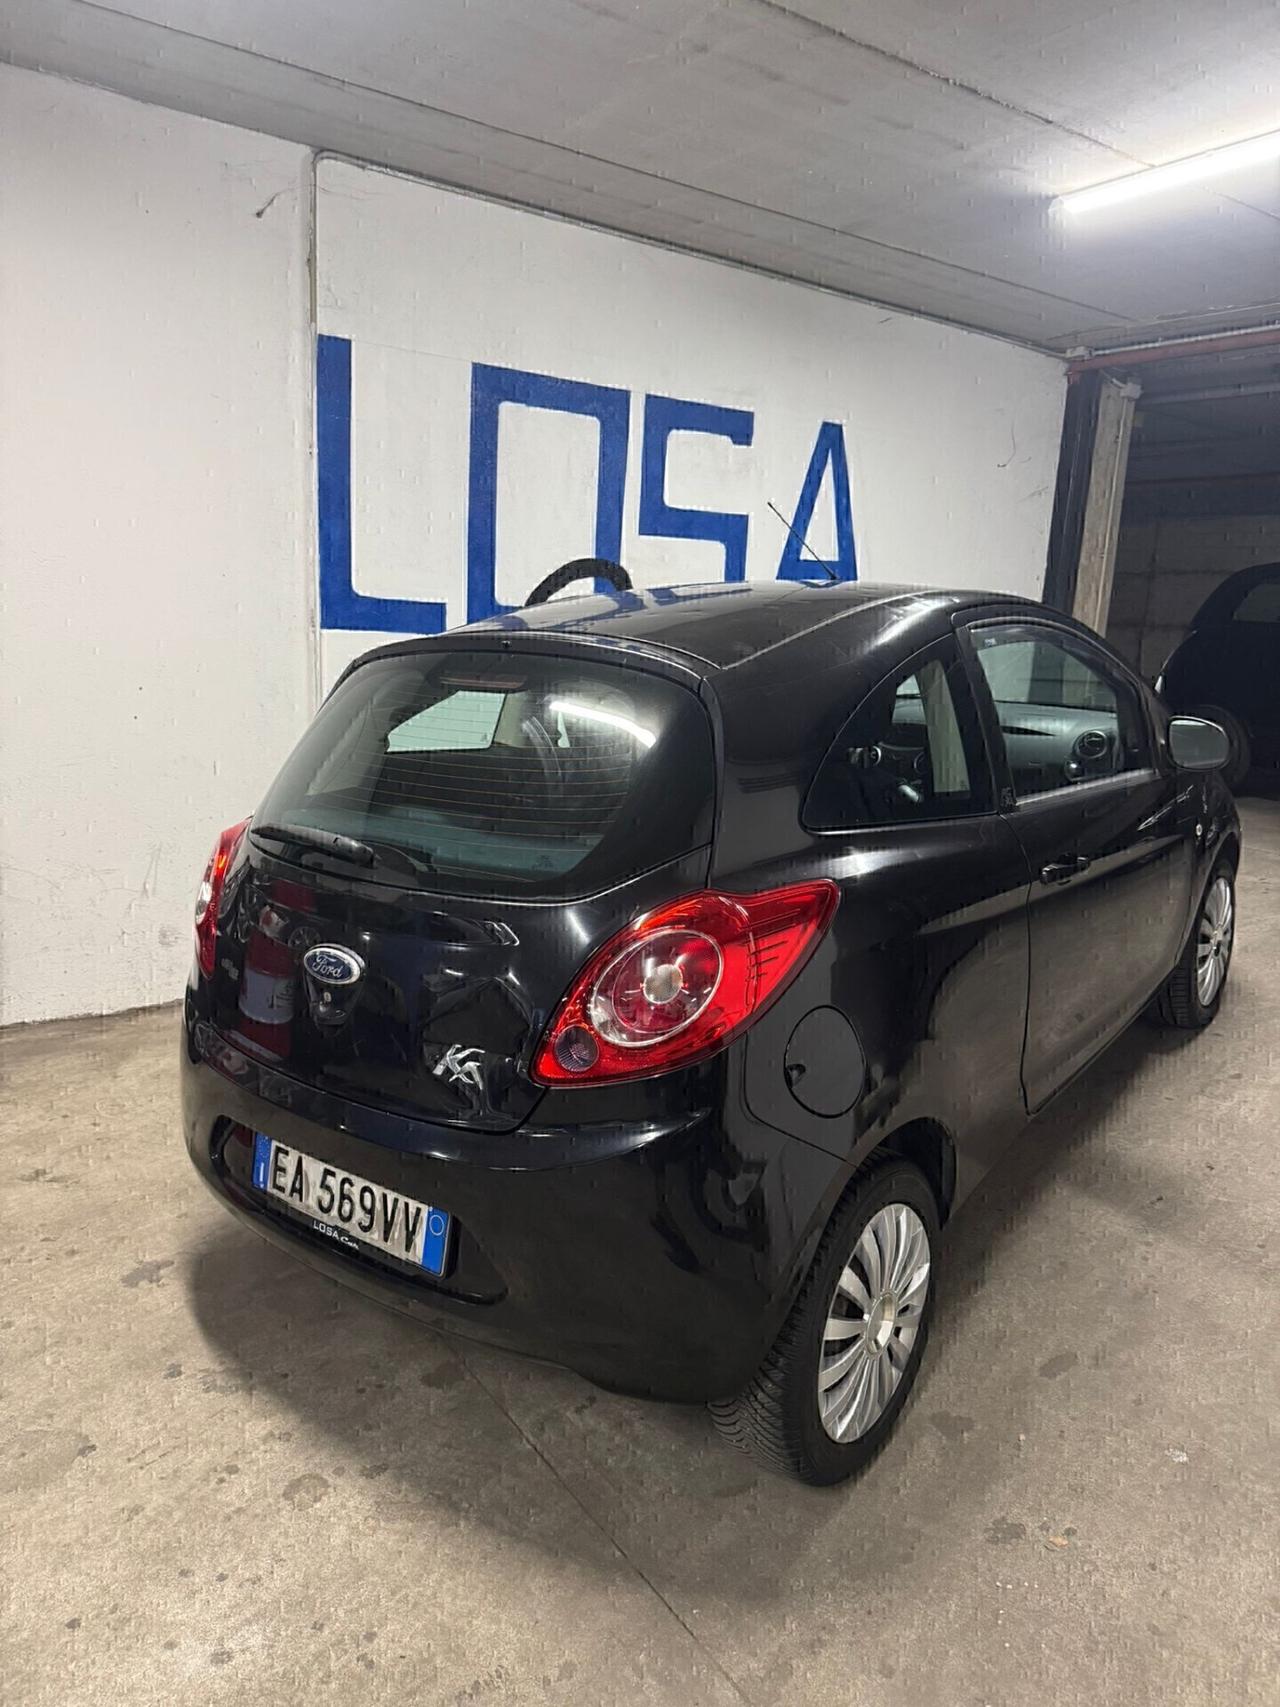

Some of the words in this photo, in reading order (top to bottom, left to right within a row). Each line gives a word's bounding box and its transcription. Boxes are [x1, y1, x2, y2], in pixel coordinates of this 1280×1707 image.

[317, 334, 858, 634] LOSA
[312, 954, 343, 978] Ford
[271, 1145, 305, 1203] EA
[317, 1168, 421, 1253] 569VV
[313, 1220, 340, 1241] LOSA
